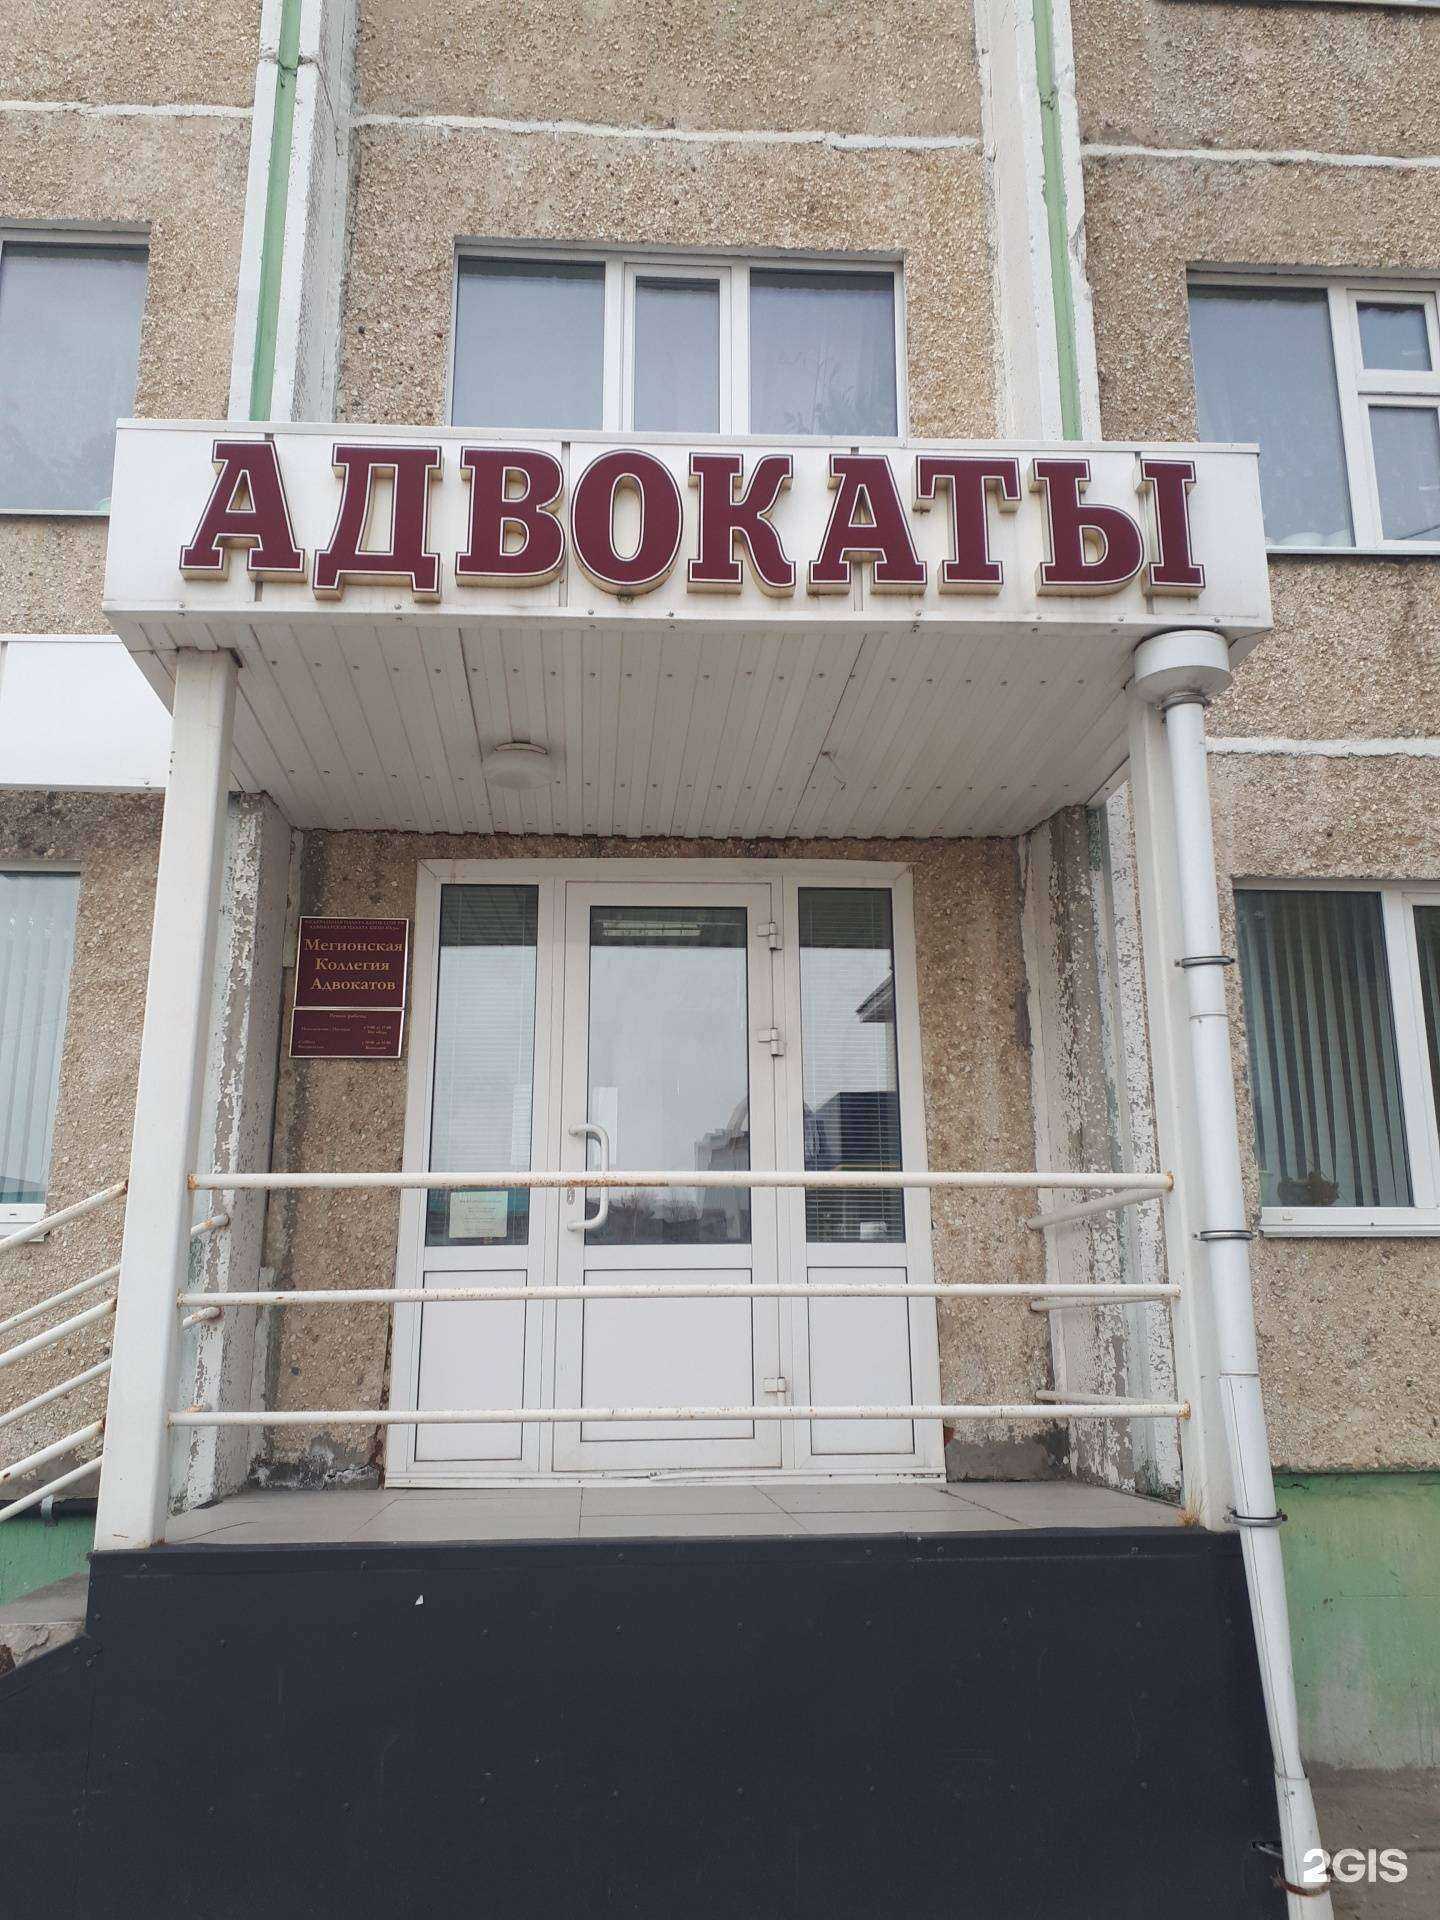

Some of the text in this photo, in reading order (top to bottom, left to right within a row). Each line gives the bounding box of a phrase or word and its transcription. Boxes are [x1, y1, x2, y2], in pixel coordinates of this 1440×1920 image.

[180, 439, 1206, 597] АДВОКАТЫ
[304, 938, 403, 952] Мегионская
[315, 957, 390, 971] Коллегия
[311, 977, 396, 990] Адвокатов
